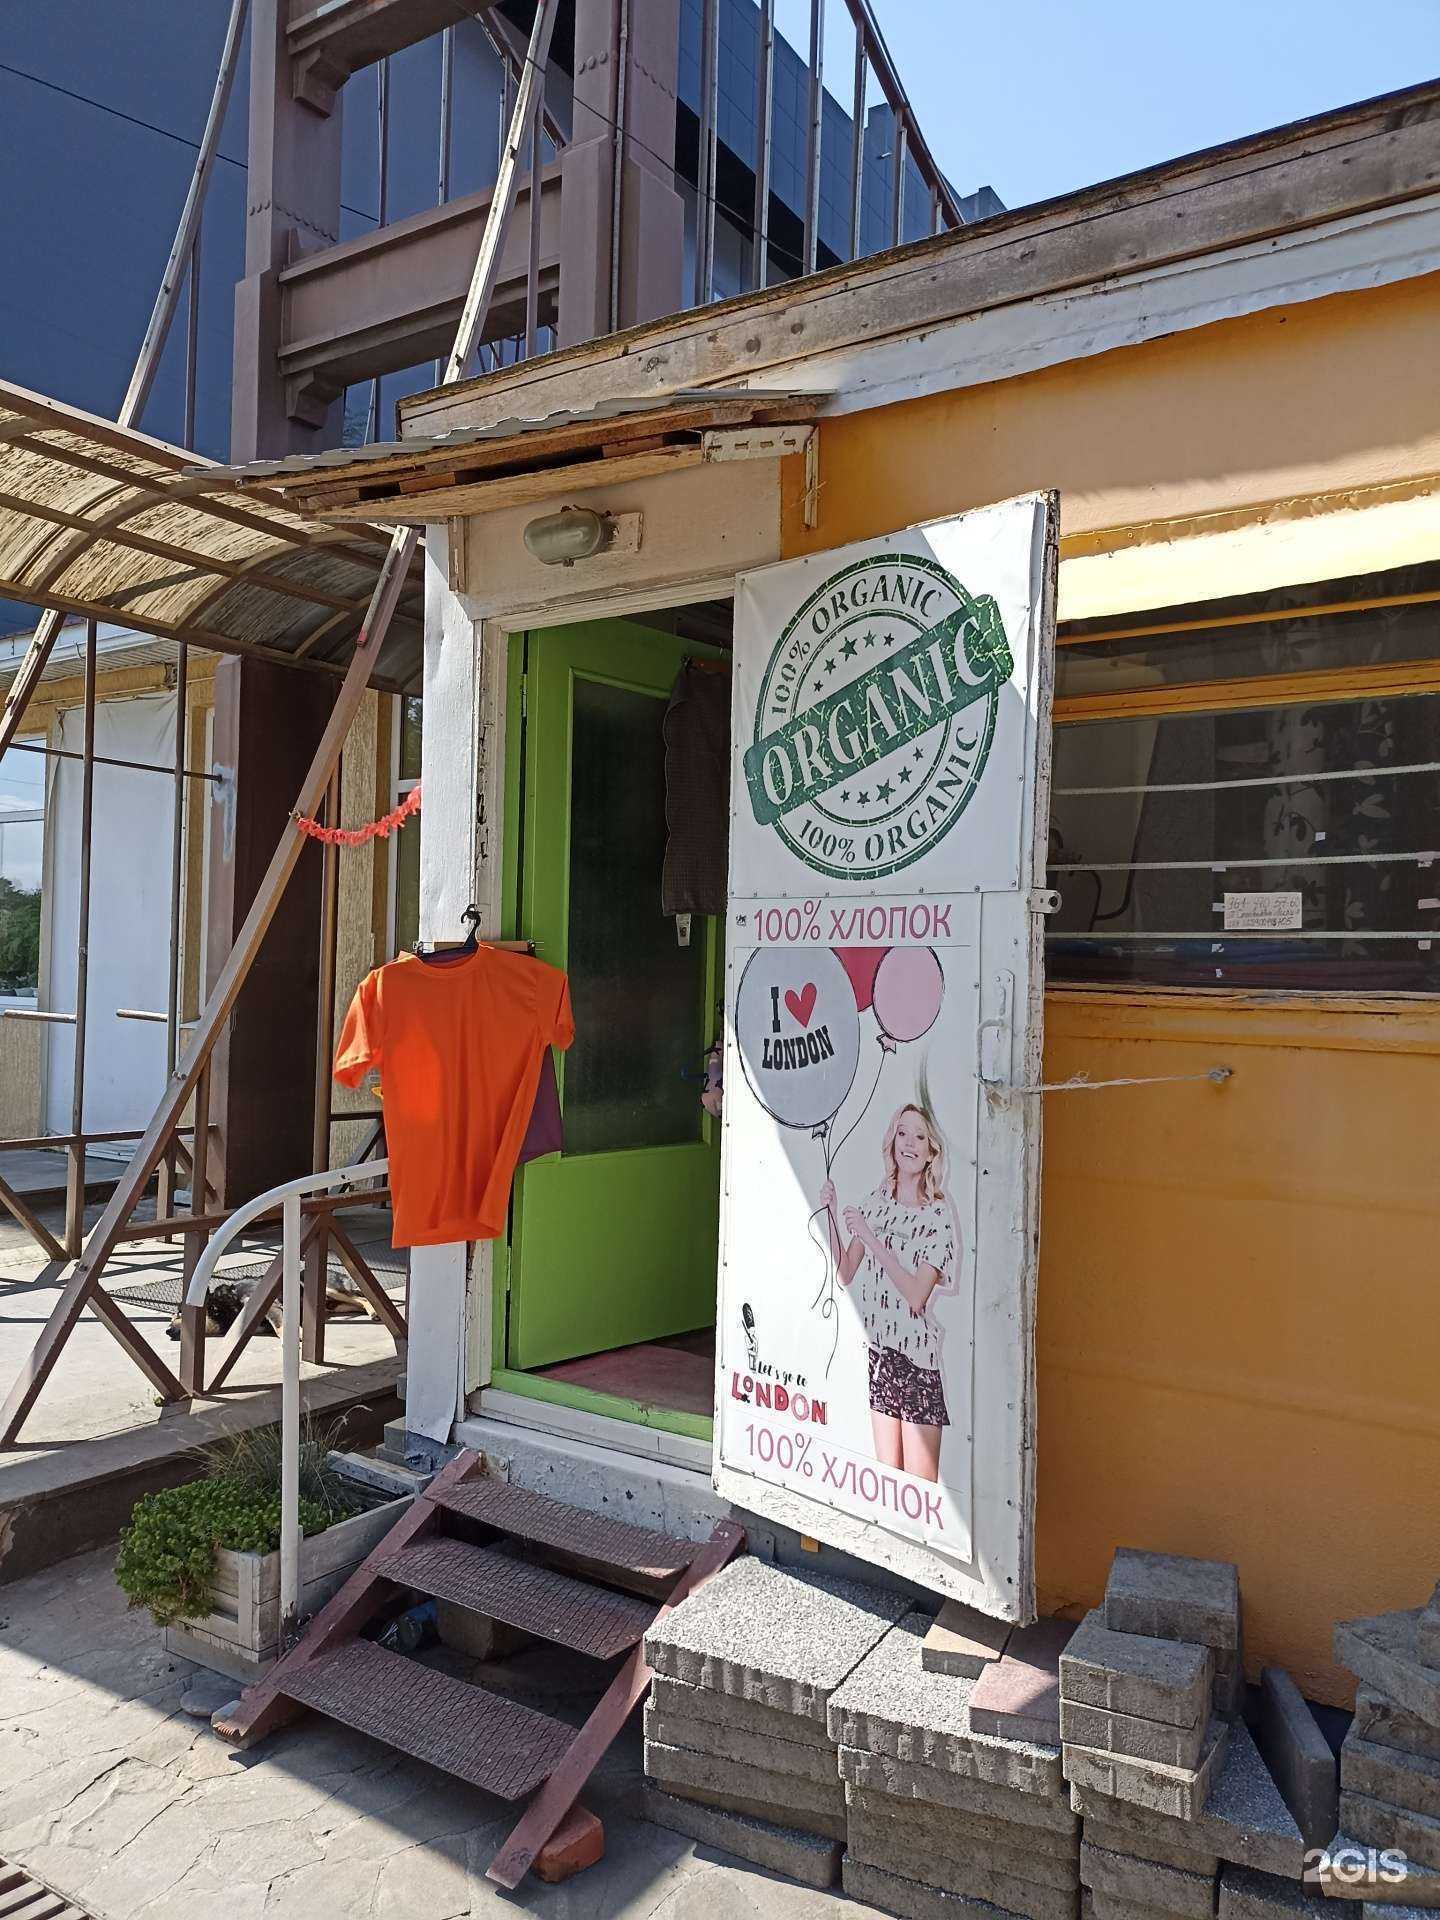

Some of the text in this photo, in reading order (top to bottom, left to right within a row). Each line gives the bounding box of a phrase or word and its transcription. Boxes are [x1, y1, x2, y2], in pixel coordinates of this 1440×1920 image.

[771, 573, 943, 717] 100% ORGANIC
[762, 616, 993, 807] ORGANIC
[798, 725, 982, 864] 100% ORGANIC
[754, 899, 953, 941] 100% ХЛОПОК
[770, 986, 781, 1033] I
[761, 1025, 835, 1071] LONDON
[731, 1371, 828, 1426] LONDON
[757, 1360, 779, 1380] Let's
[782, 1371, 793, 1386] go
[745, 1423, 945, 1530] 100% ХЛОПОК
